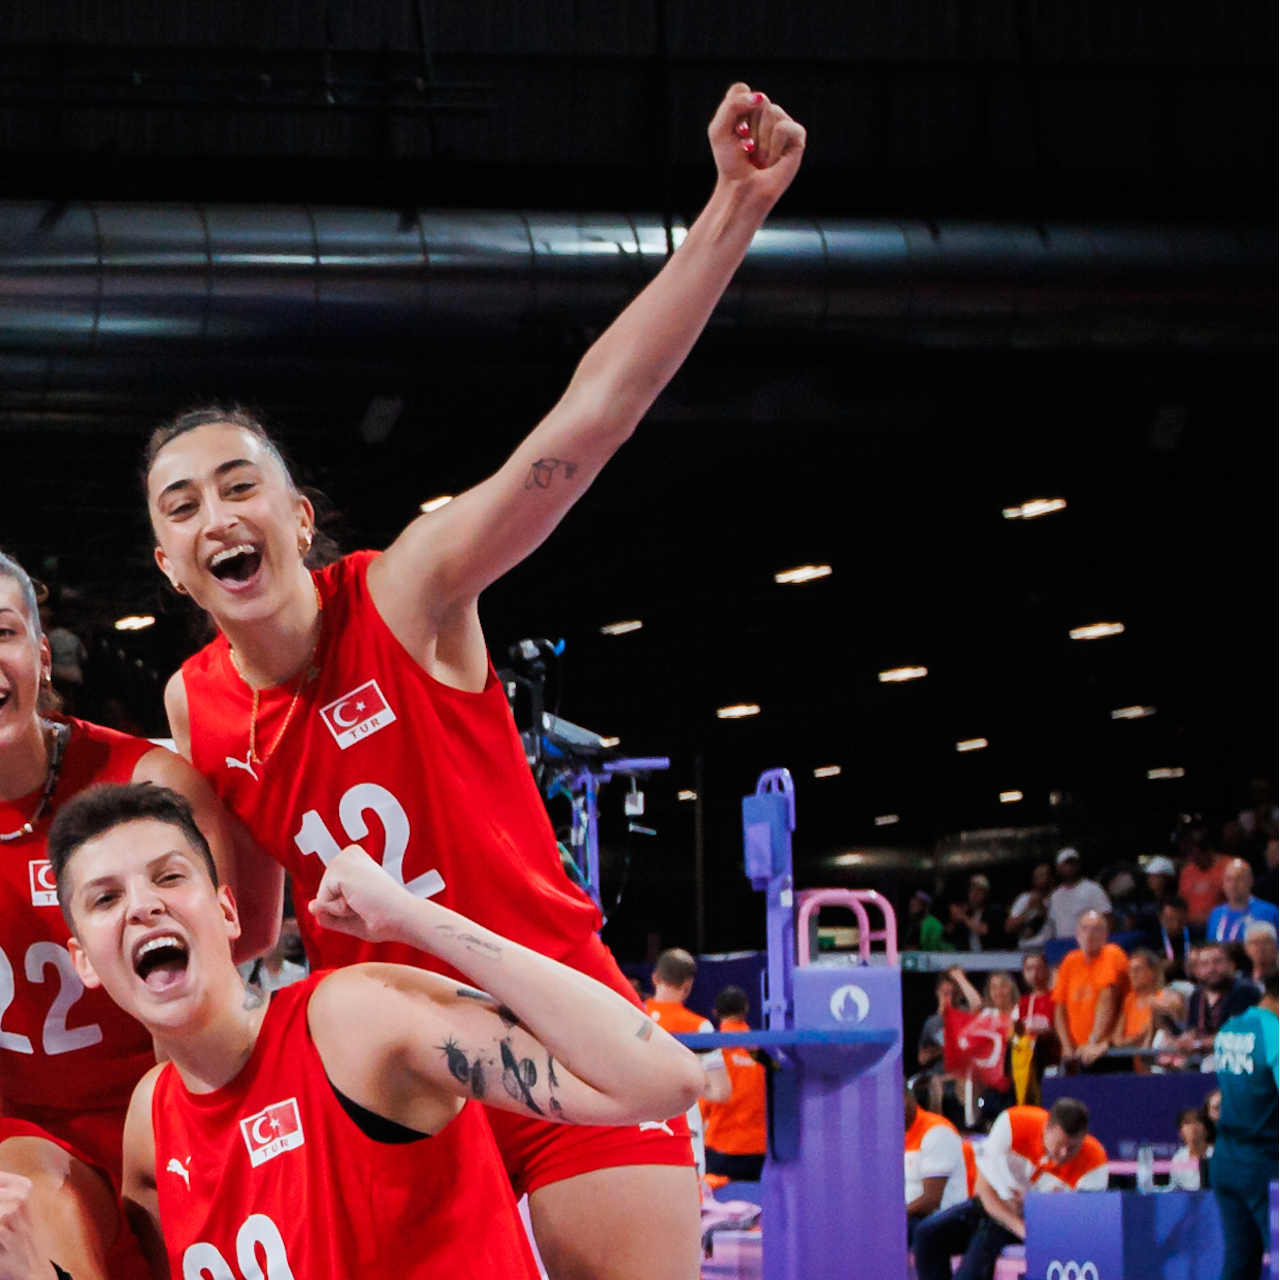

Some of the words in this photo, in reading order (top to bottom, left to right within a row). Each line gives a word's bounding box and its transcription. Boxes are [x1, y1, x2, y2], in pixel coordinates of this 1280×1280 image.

[350, 718, 381, 739] TUR
[294, 782, 446, 899] 12
[261, 1139, 289, 1158] TUR
